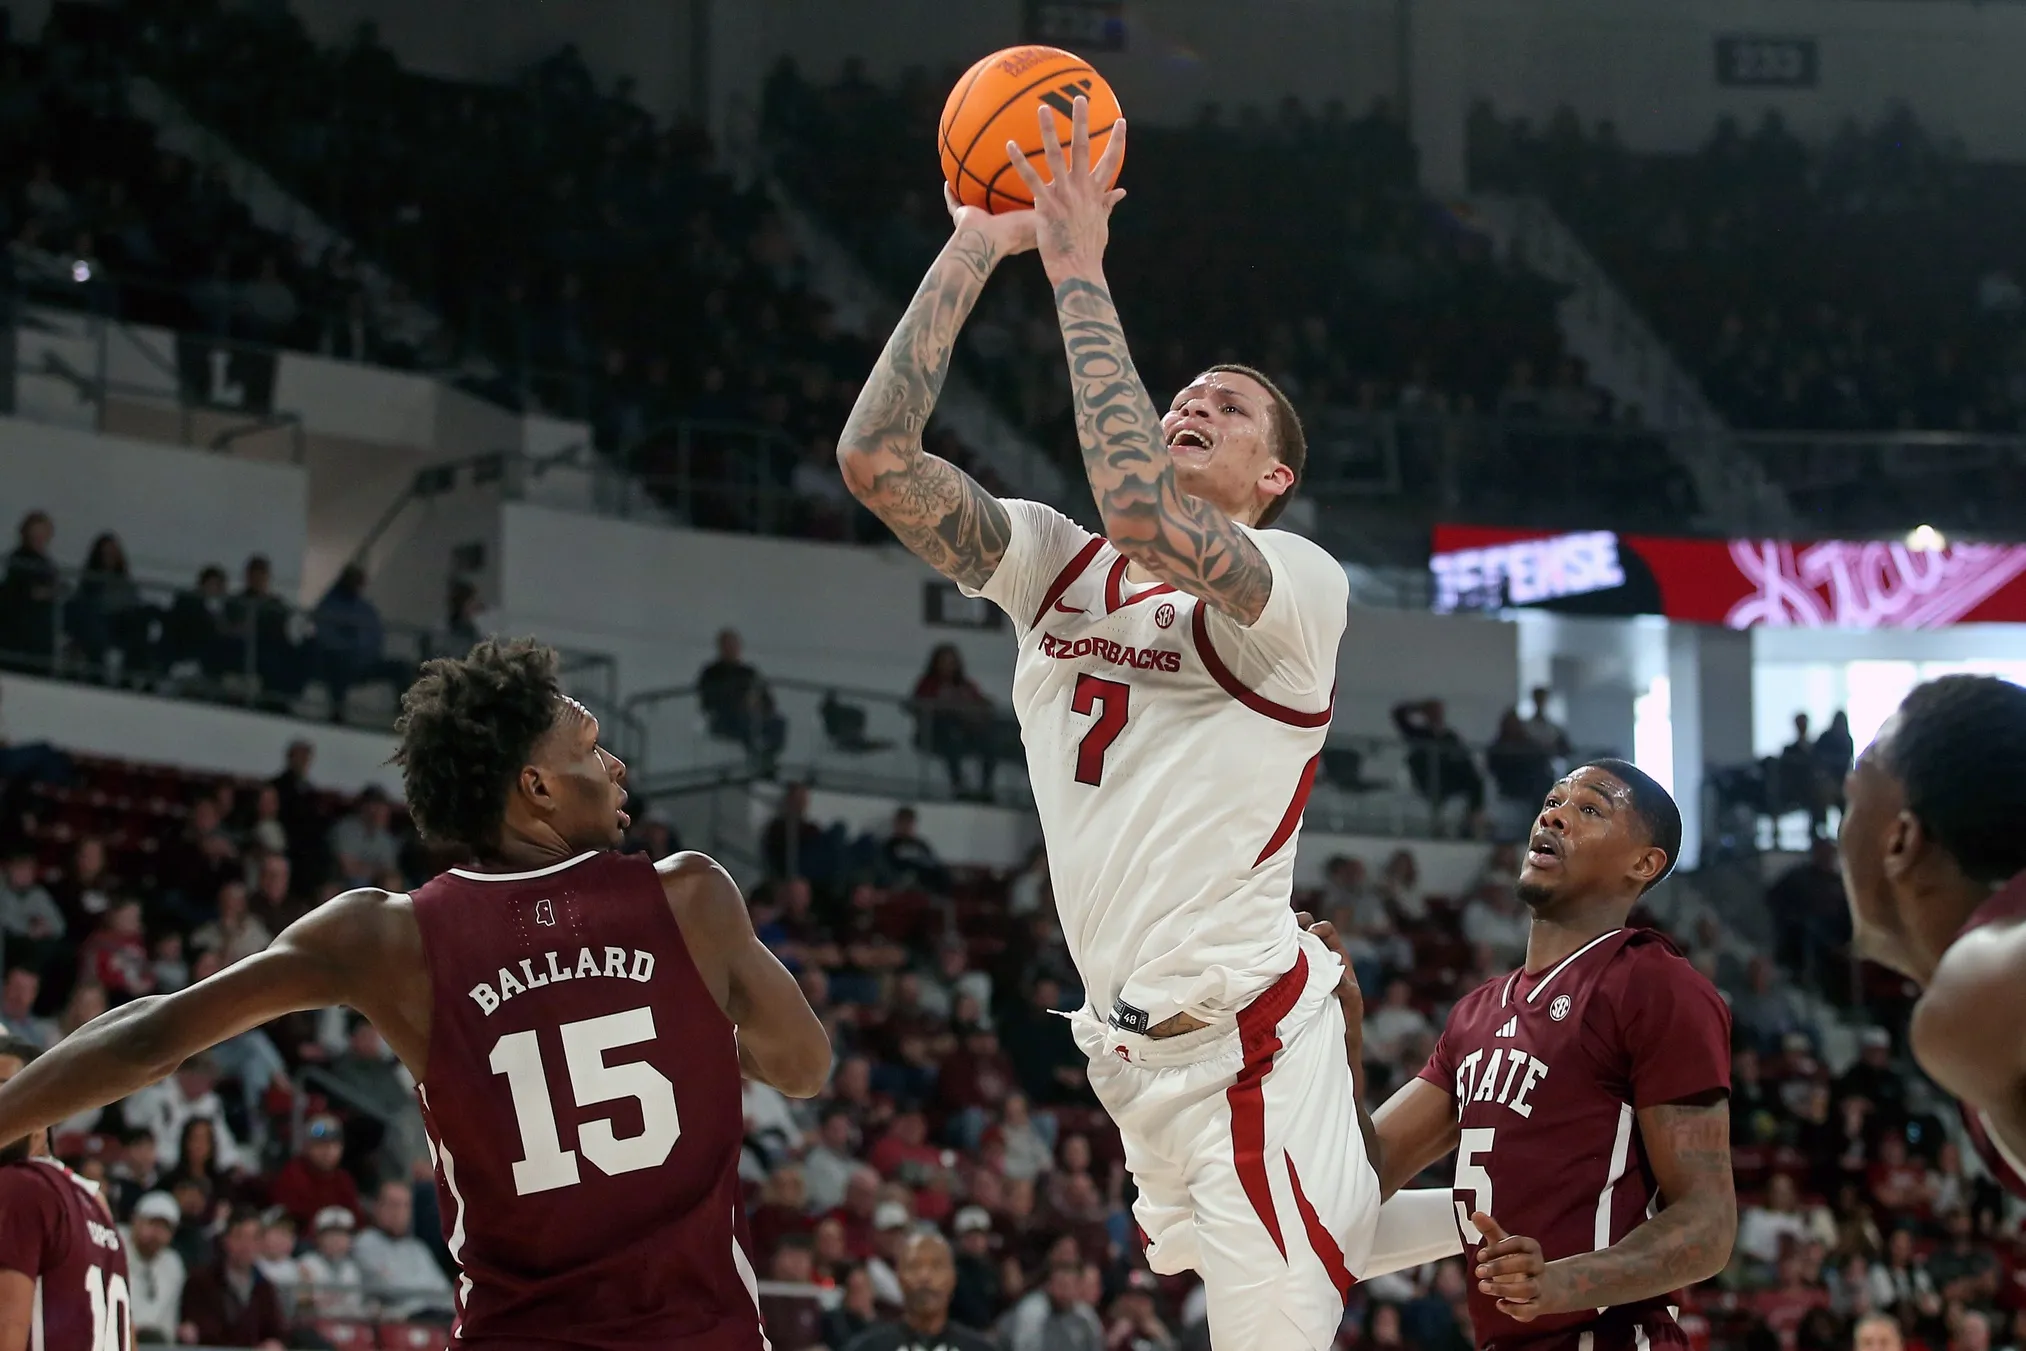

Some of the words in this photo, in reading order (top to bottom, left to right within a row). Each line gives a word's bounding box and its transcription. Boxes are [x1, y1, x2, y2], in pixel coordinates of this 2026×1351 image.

[1038, 631, 1181, 672] RZORBACKS
[1155, 604, 1174, 628] SEC
[1071, 672, 1130, 787] 7
[468, 946, 655, 1016] BALLARD
[1551, 996, 1569, 1019] SEC
[1123, 1013, 1137, 1025] 48
[488, 1005, 682, 1196] 15
[1456, 1048, 1549, 1123] STATE
[1453, 1127, 1496, 1246] 5
[85, 1264, 131, 1351] 10
